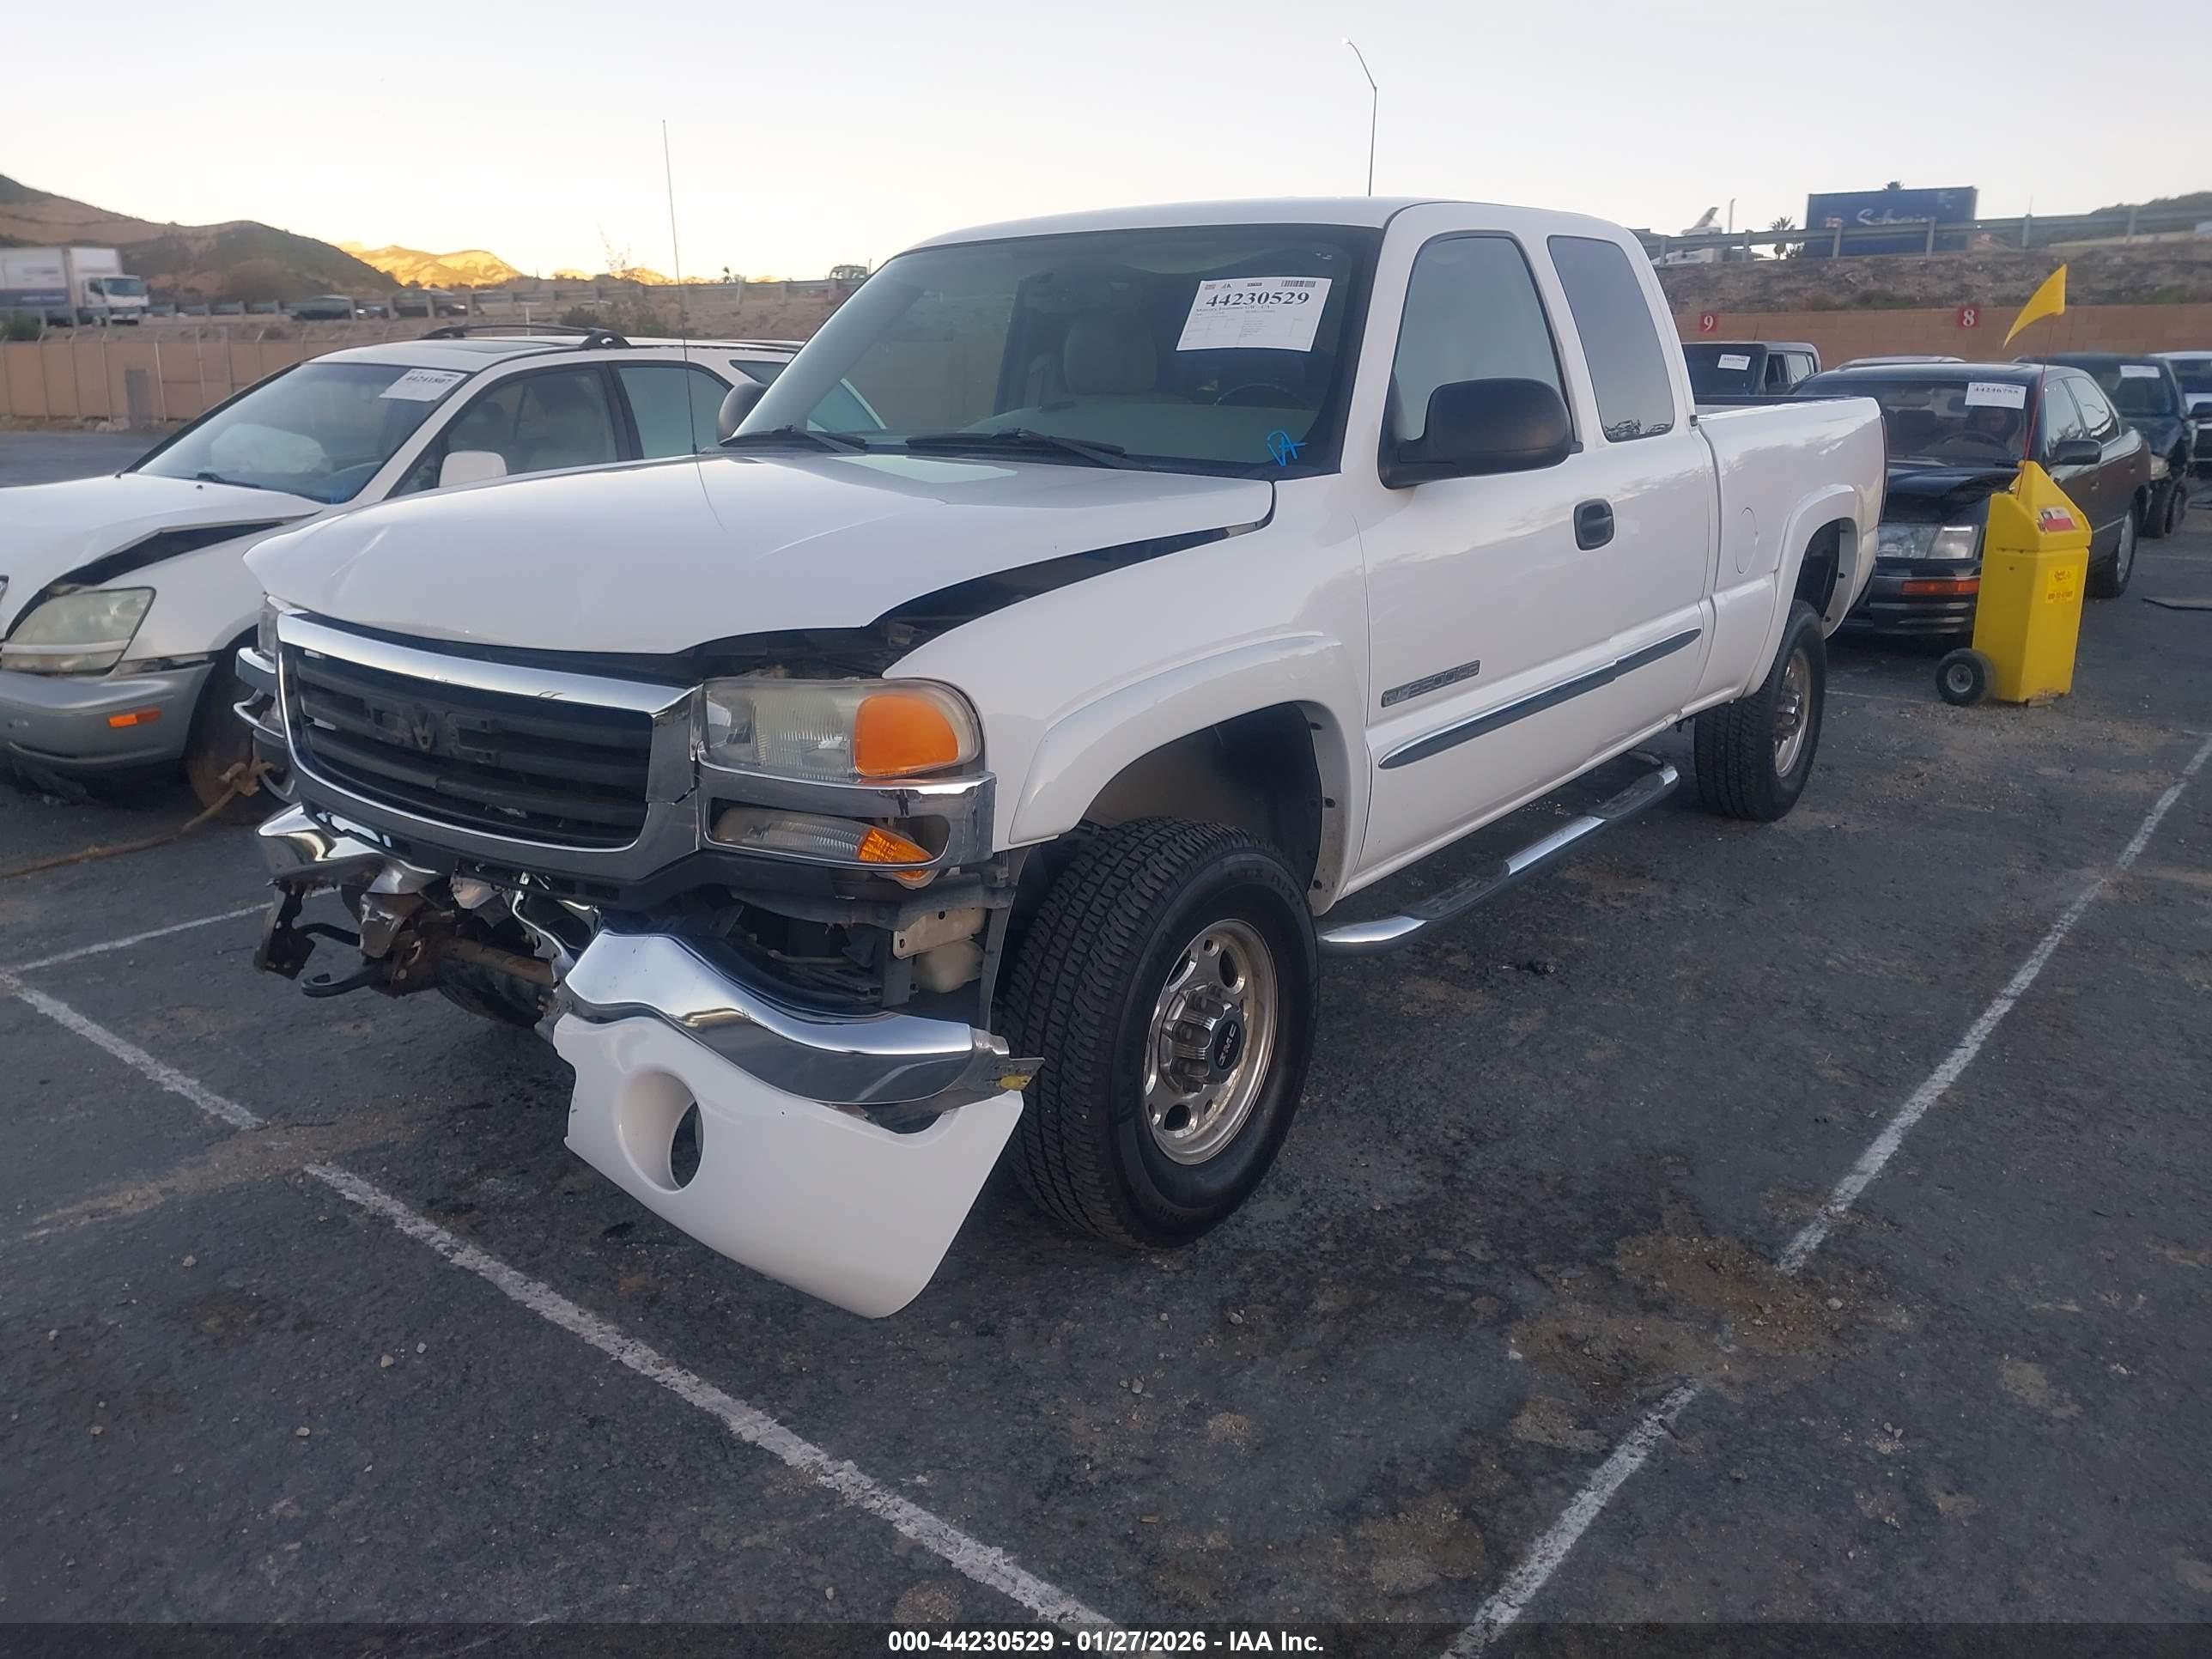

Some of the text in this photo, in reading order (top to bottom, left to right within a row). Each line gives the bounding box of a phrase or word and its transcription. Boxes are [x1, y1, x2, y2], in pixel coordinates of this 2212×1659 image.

[1206, 291, 1310, 307] 44230529
[1704, 315, 1714, 331] 9
[1963, 309, 1975, 326] 8
[1218, 1023, 1237, 1066] GMC
